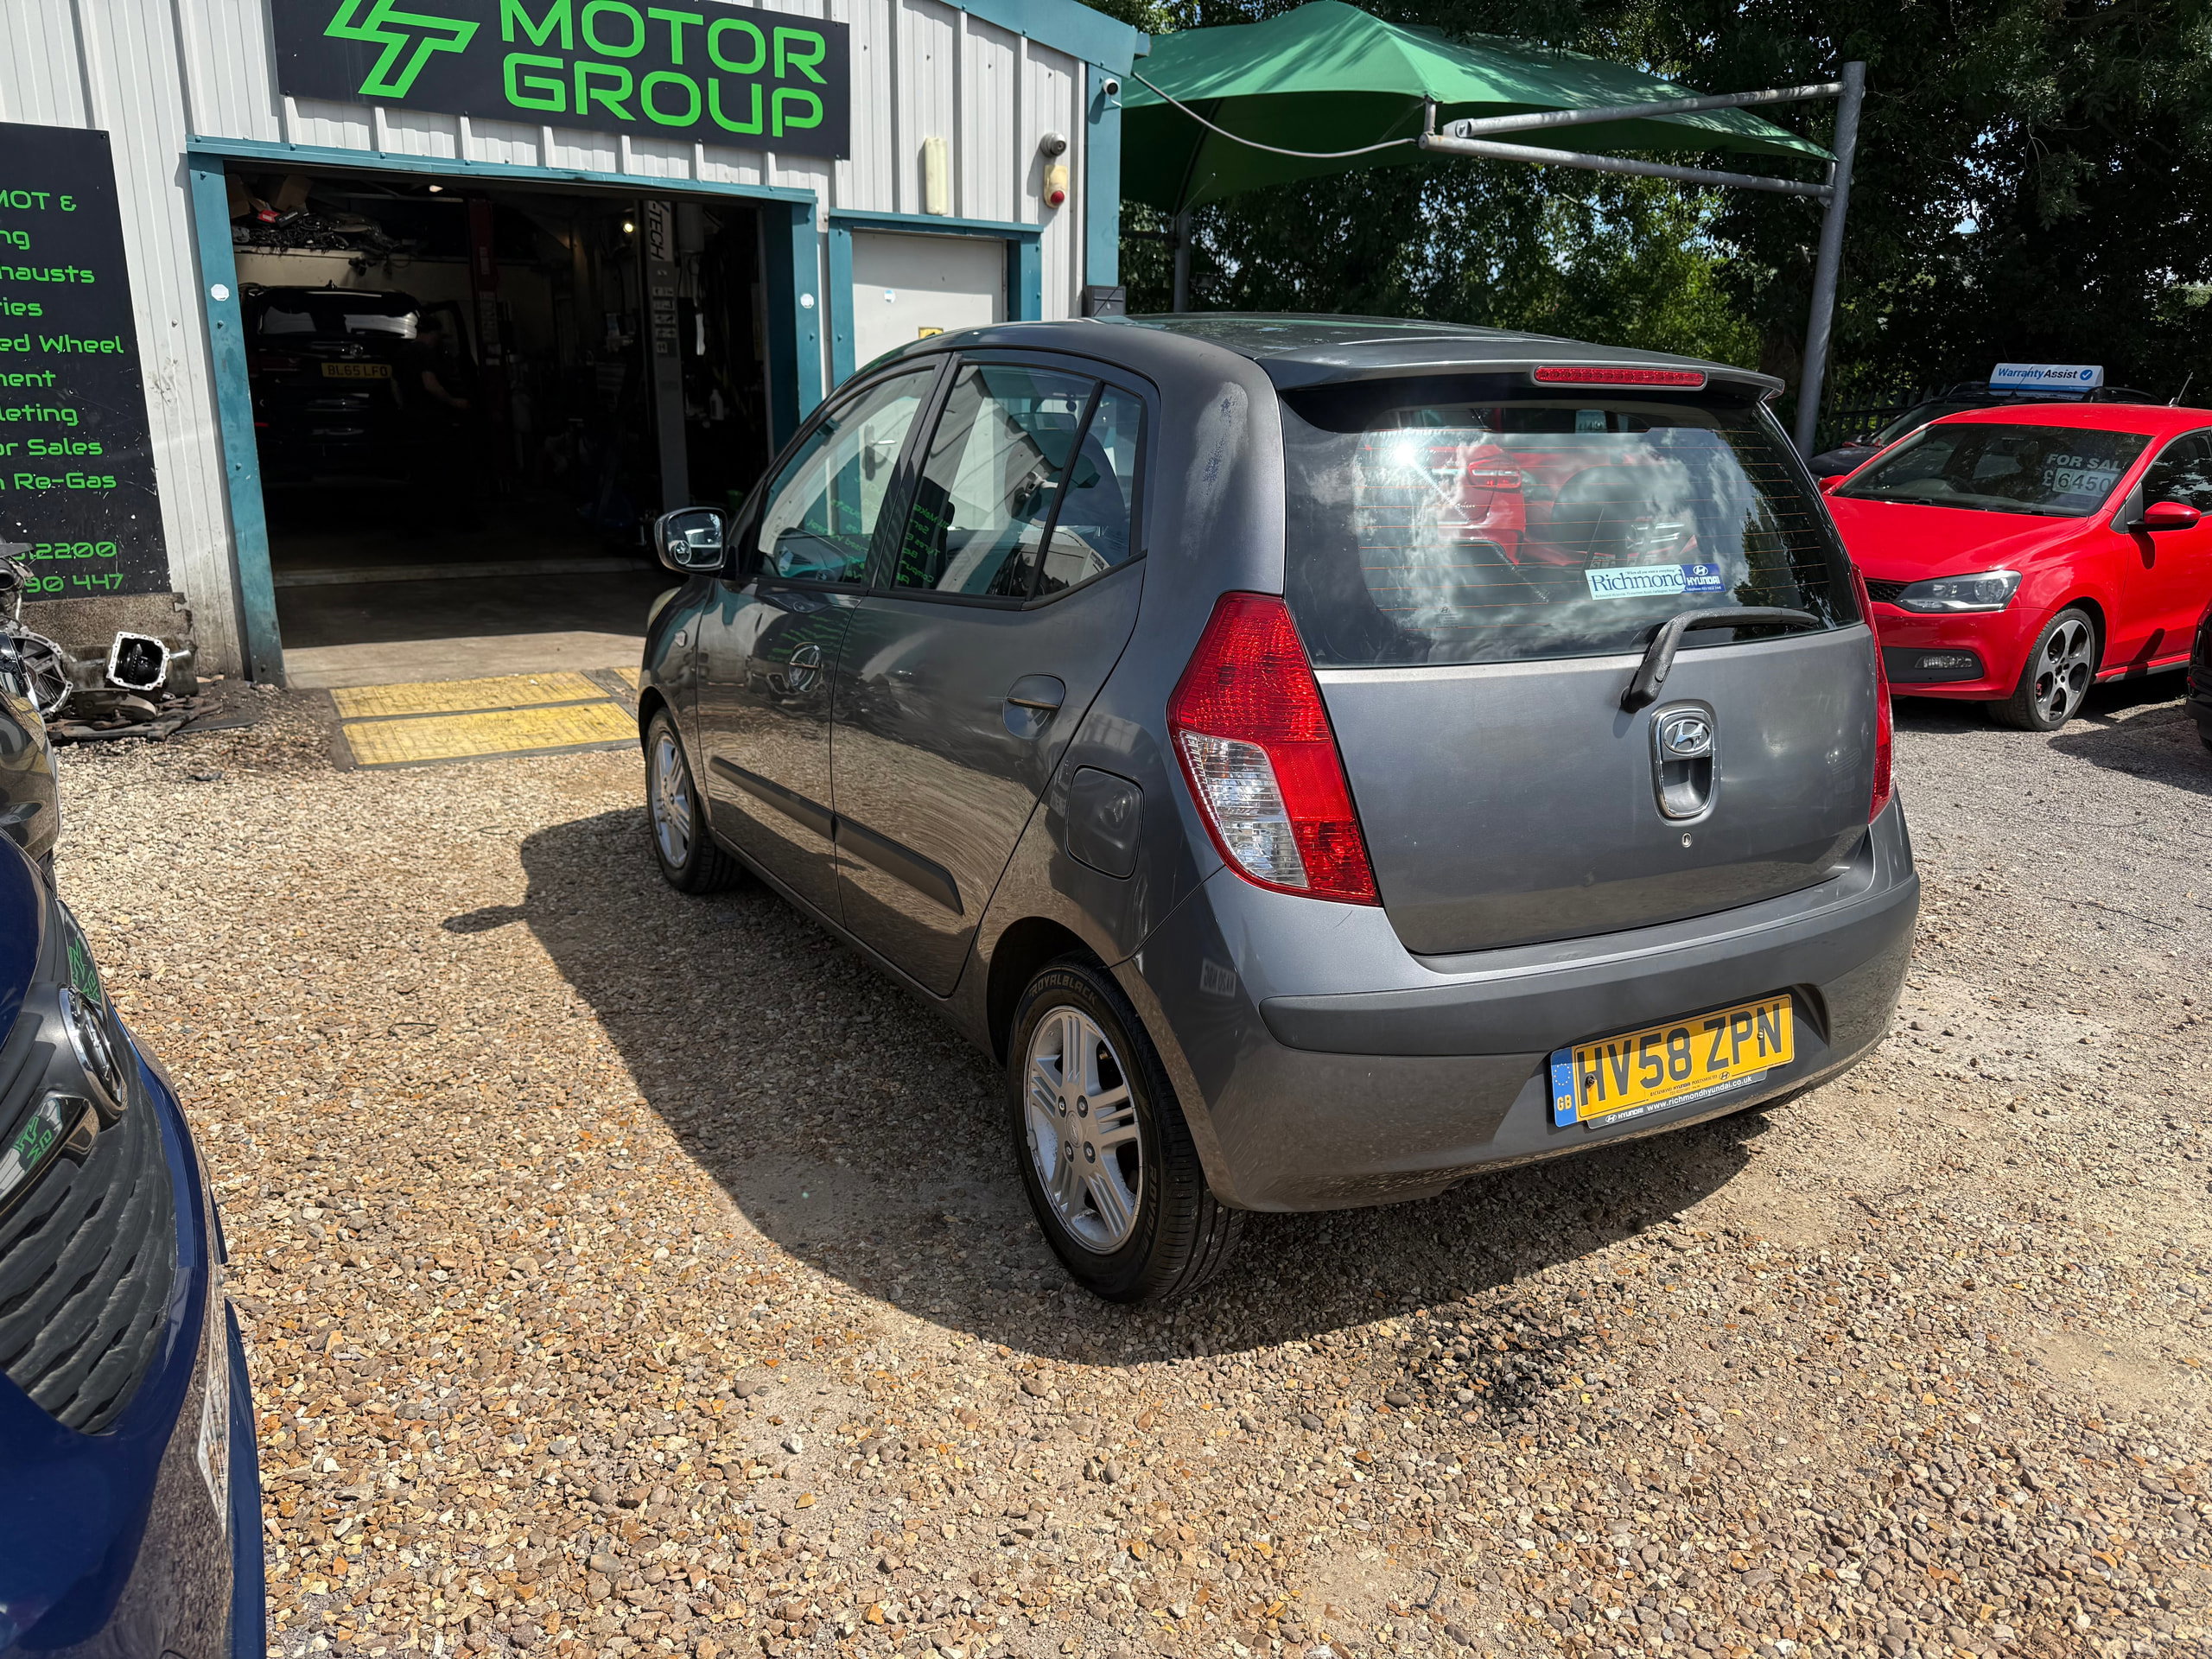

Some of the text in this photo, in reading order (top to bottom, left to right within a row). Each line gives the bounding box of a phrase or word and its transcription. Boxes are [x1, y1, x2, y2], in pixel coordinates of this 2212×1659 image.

[501, 0, 827, 85] MOTOR
[504, 53, 823, 138] GROUP
[60, 195, 77, 212] &
[39, 334, 124, 353] Wheel
[1998, 367, 2078, 380] WarrantyAssist
[27, 438, 103, 456] Sales
[2046, 454, 2083, 468] FOR
[13, 472, 118, 490] Re-Gas
[20, 574, 124, 594] 90 447
[1592, 569, 1685, 592] Richmond
[1687, 575, 1720, 586] HYUNDAI
[1576, 1002, 1782, 1108] HV58 ZPN
[1556, 1096, 1573, 1111] GB
[1618, 1108, 1643, 1119] HYUNDAI
[1647, 1075, 1752, 1112] www.richmondhyundai.co.uk
